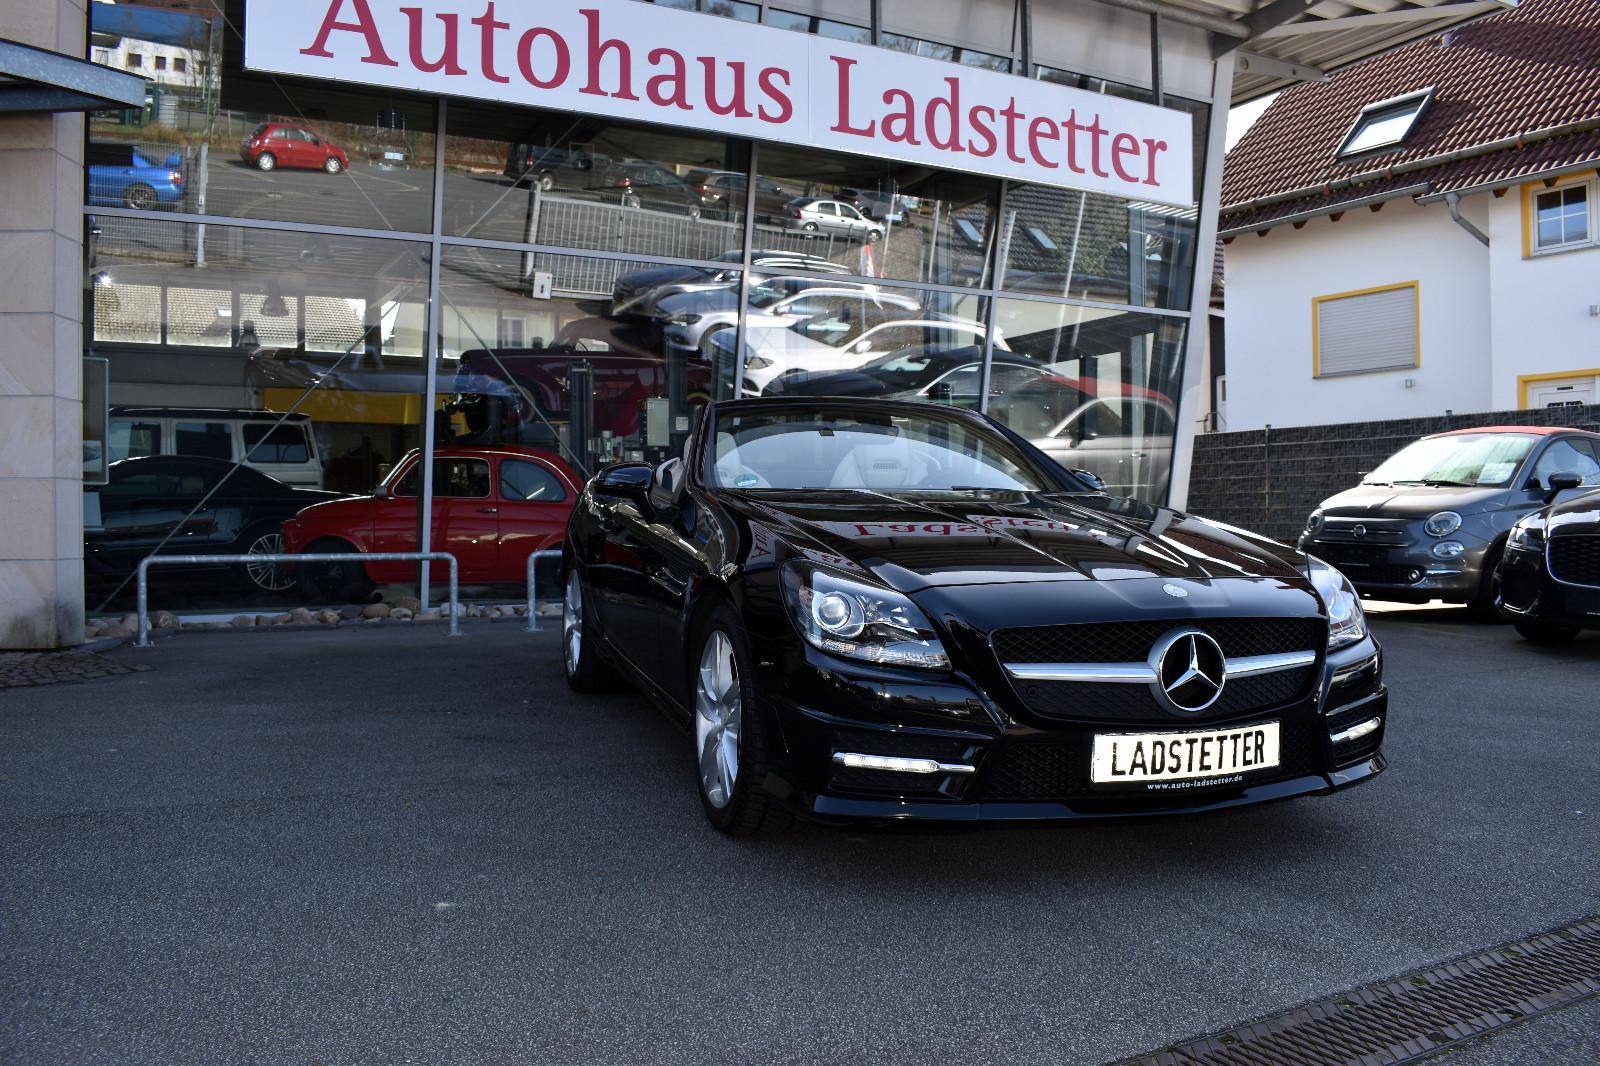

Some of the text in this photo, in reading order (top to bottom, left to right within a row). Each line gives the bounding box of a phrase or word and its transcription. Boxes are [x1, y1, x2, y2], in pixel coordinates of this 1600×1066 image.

[300, 0, 1167, 187] Autohaus Ladstetter
[1111, 730, 1265, 776] LADSTETTER
[1147, 774, 1243, 790] www.auto-ladstetter.de
